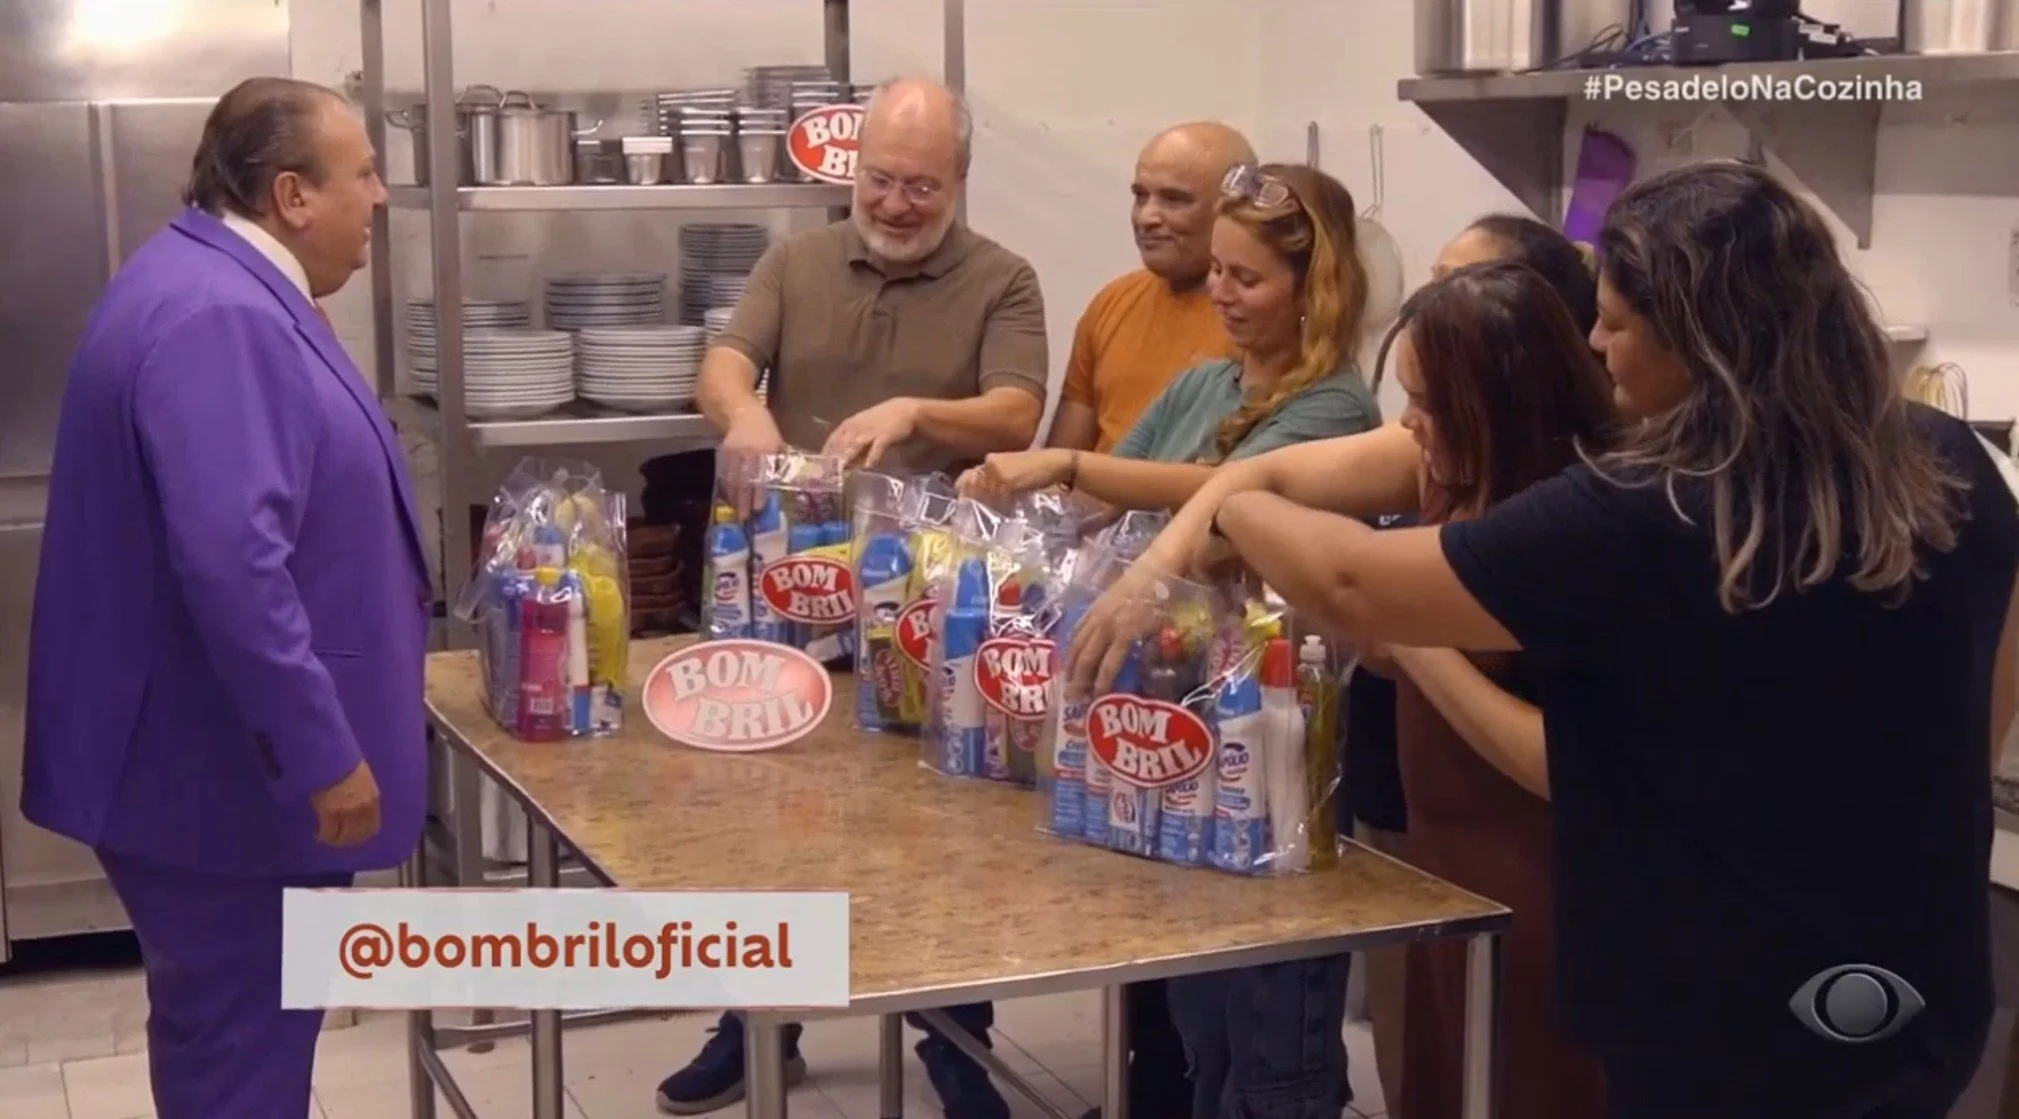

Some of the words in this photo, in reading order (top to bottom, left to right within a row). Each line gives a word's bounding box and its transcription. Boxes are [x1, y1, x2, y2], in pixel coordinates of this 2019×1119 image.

[769, 563, 839, 592] BOM
[666, 650, 788, 701] BOM
[983, 648, 1052, 679] BOM
[691, 692, 814, 740] BRIL
[1096, 702, 1172, 744] BOM
[1112, 738, 1202, 778] BRIL
